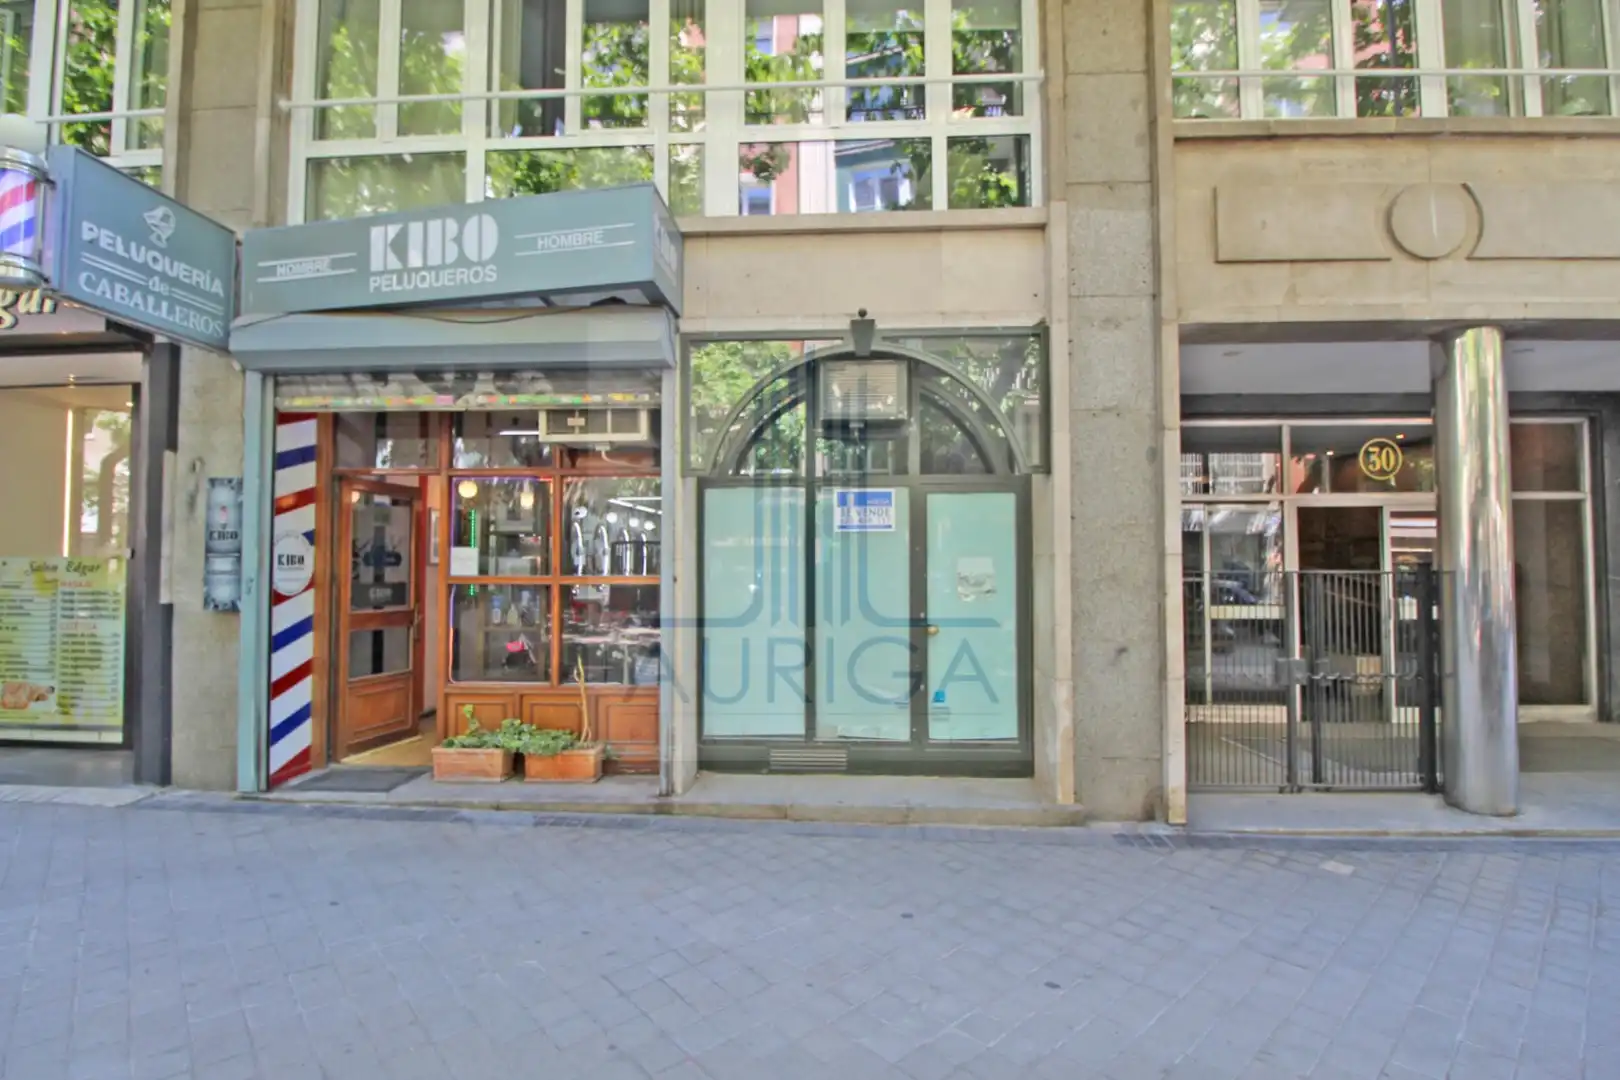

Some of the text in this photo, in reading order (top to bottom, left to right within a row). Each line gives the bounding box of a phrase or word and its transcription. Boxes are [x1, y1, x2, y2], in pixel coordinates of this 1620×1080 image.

[370, 213, 498, 272] KIBO
[538, 230, 604, 249] HOMBRE
[81, 220, 225, 297] PELUQUERÍA
[276, 256, 331, 277] HOMBRE
[149, 276, 170, 296] de
[369, 264, 497, 293] PELUQUEROS
[78, 271, 224, 337] CABALLEROS
[1368, 446, 1395, 471] 30
[210, 530, 239, 541] KIBO
[66, 560, 101, 577] Edgar
[277, 554, 305, 566] KIBO
